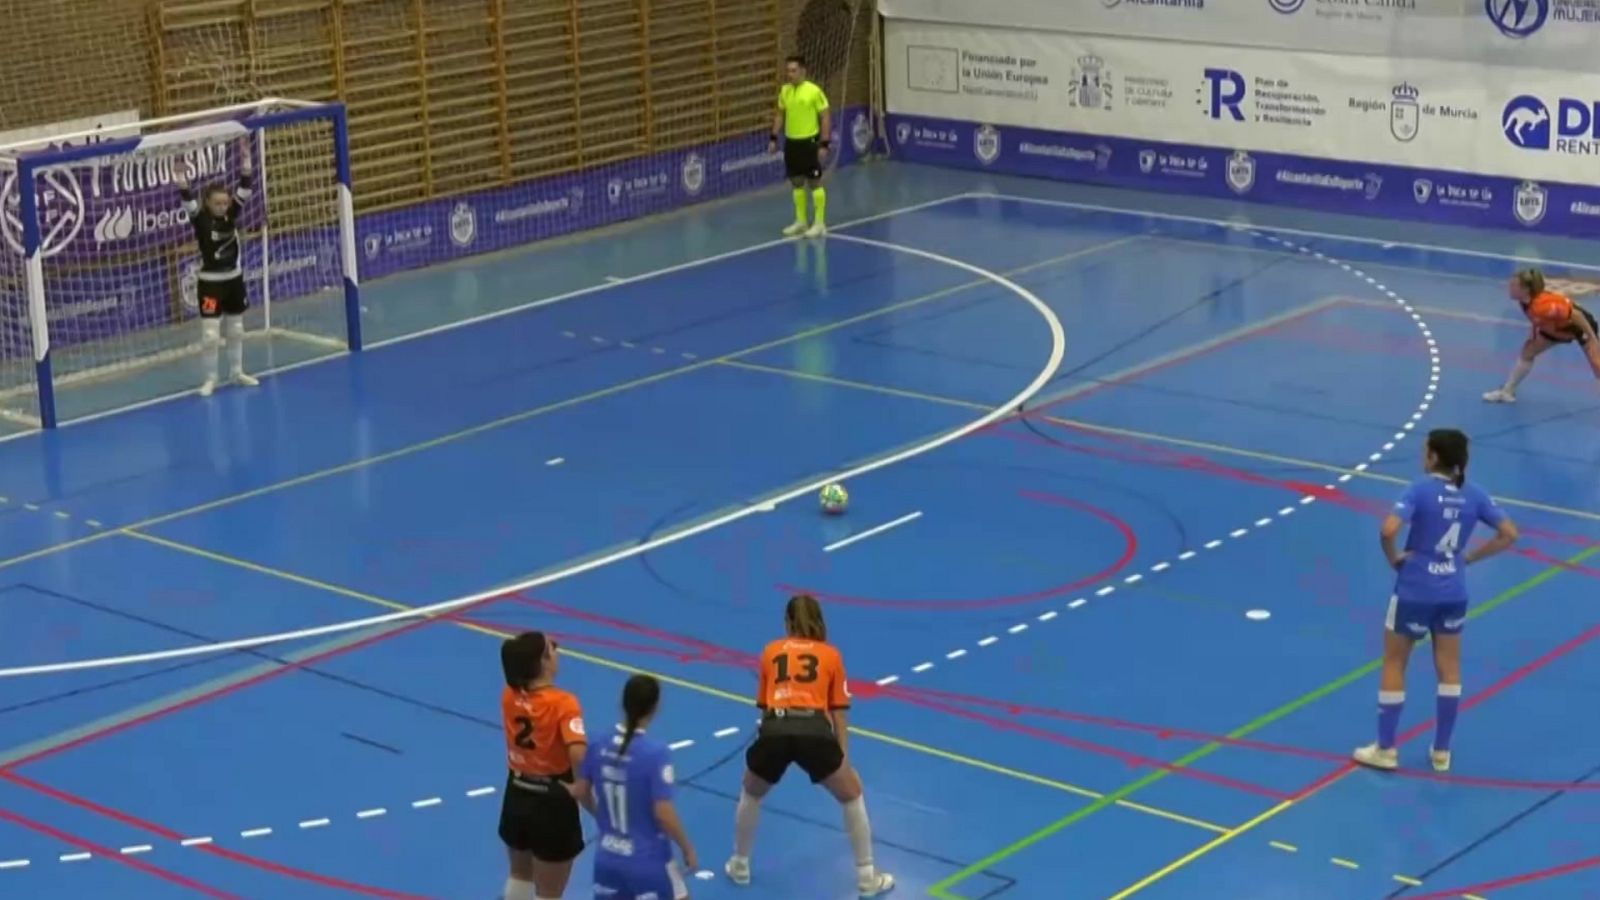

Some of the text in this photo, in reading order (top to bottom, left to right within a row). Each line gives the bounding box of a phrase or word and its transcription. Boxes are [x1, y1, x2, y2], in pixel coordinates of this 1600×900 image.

[1255, 77, 1289, 88] Plan de
[1348, 96, 1478, 119] Región de Murcia
[1434, 521, 1461, 559] 4
[772, 652, 819, 684] 13
[514, 715, 537, 751] 2
[603, 781, 628, 835] 11
